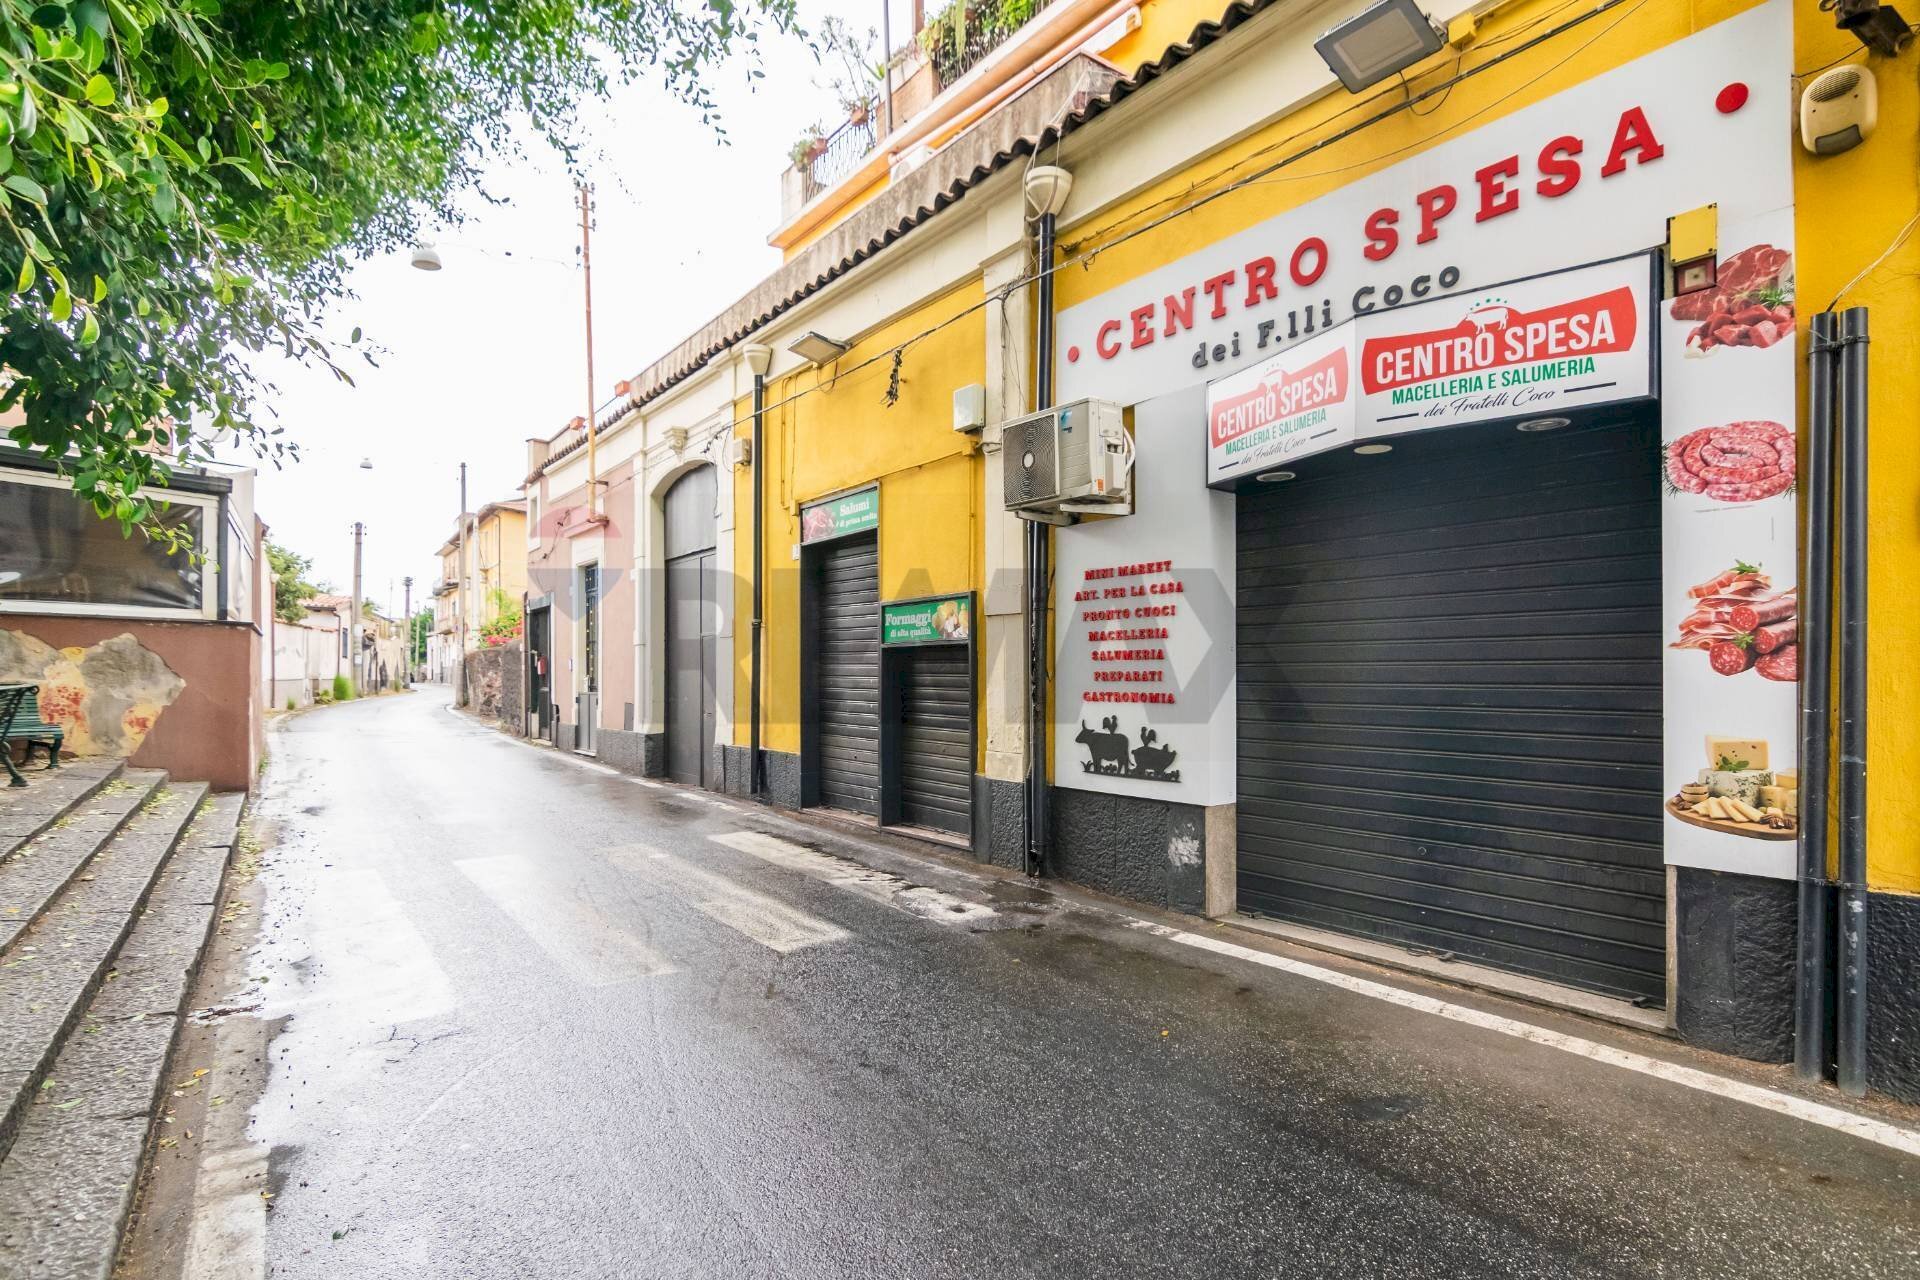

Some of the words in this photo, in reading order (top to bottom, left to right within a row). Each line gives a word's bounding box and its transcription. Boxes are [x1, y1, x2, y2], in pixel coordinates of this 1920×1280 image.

[1096, 238, 1329, 360] CENTRO
[1363, 105, 1665, 262] SPESA
[1191, 331, 1241, 369] dei
[1352, 265, 1461, 314] Coco
[1376, 331, 1495, 384] CENTRO
[1504, 309, 1616, 362] SPESA
[1392, 374, 1484, 405] MACELLERIA
[1488, 372, 1497, 389] E
[1501, 356, 1596, 386] SALUMERIA
[1217, 391, 1276, 439] CENTRO
[1280, 367, 1338, 415] SPESA
[1424, 403, 1445, 418] dei
[1450, 394, 1508, 418] Fratelli
[1512, 386, 1556, 407] Coco
[1225, 428, 1270, 456] MACELLERIA
[1272, 427, 1277, 440] E
[1279, 408, 1327, 437] SALUMERIA
[1254, 438, 1283, 462] Fratelli
[1284, 437, 1306, 454] Coco
[840, 498, 869, 516] Salumi
[1084, 568, 1114, 581] MINI
[1118, 560, 1172, 577] MARKET
[1103, 587, 1126, 599] PER
[1130, 585, 1146, 597] LA
[1150, 581, 1184, 595] CASA
[885, 609, 931, 627] Formaggi
[1082, 607, 1130, 622] PRONTO
[1135, 605, 1176, 618] CUOCI
[890, 630, 897, 638] di
[898, 629, 909, 637] alta
[1088, 628, 1169, 642] MACELLERIA
[1091, 649, 1165, 662] SALUMERIA
[1093, 670, 1163, 682] PREPARATI
[1083, 691, 1176, 704] GASTRONOMIA
